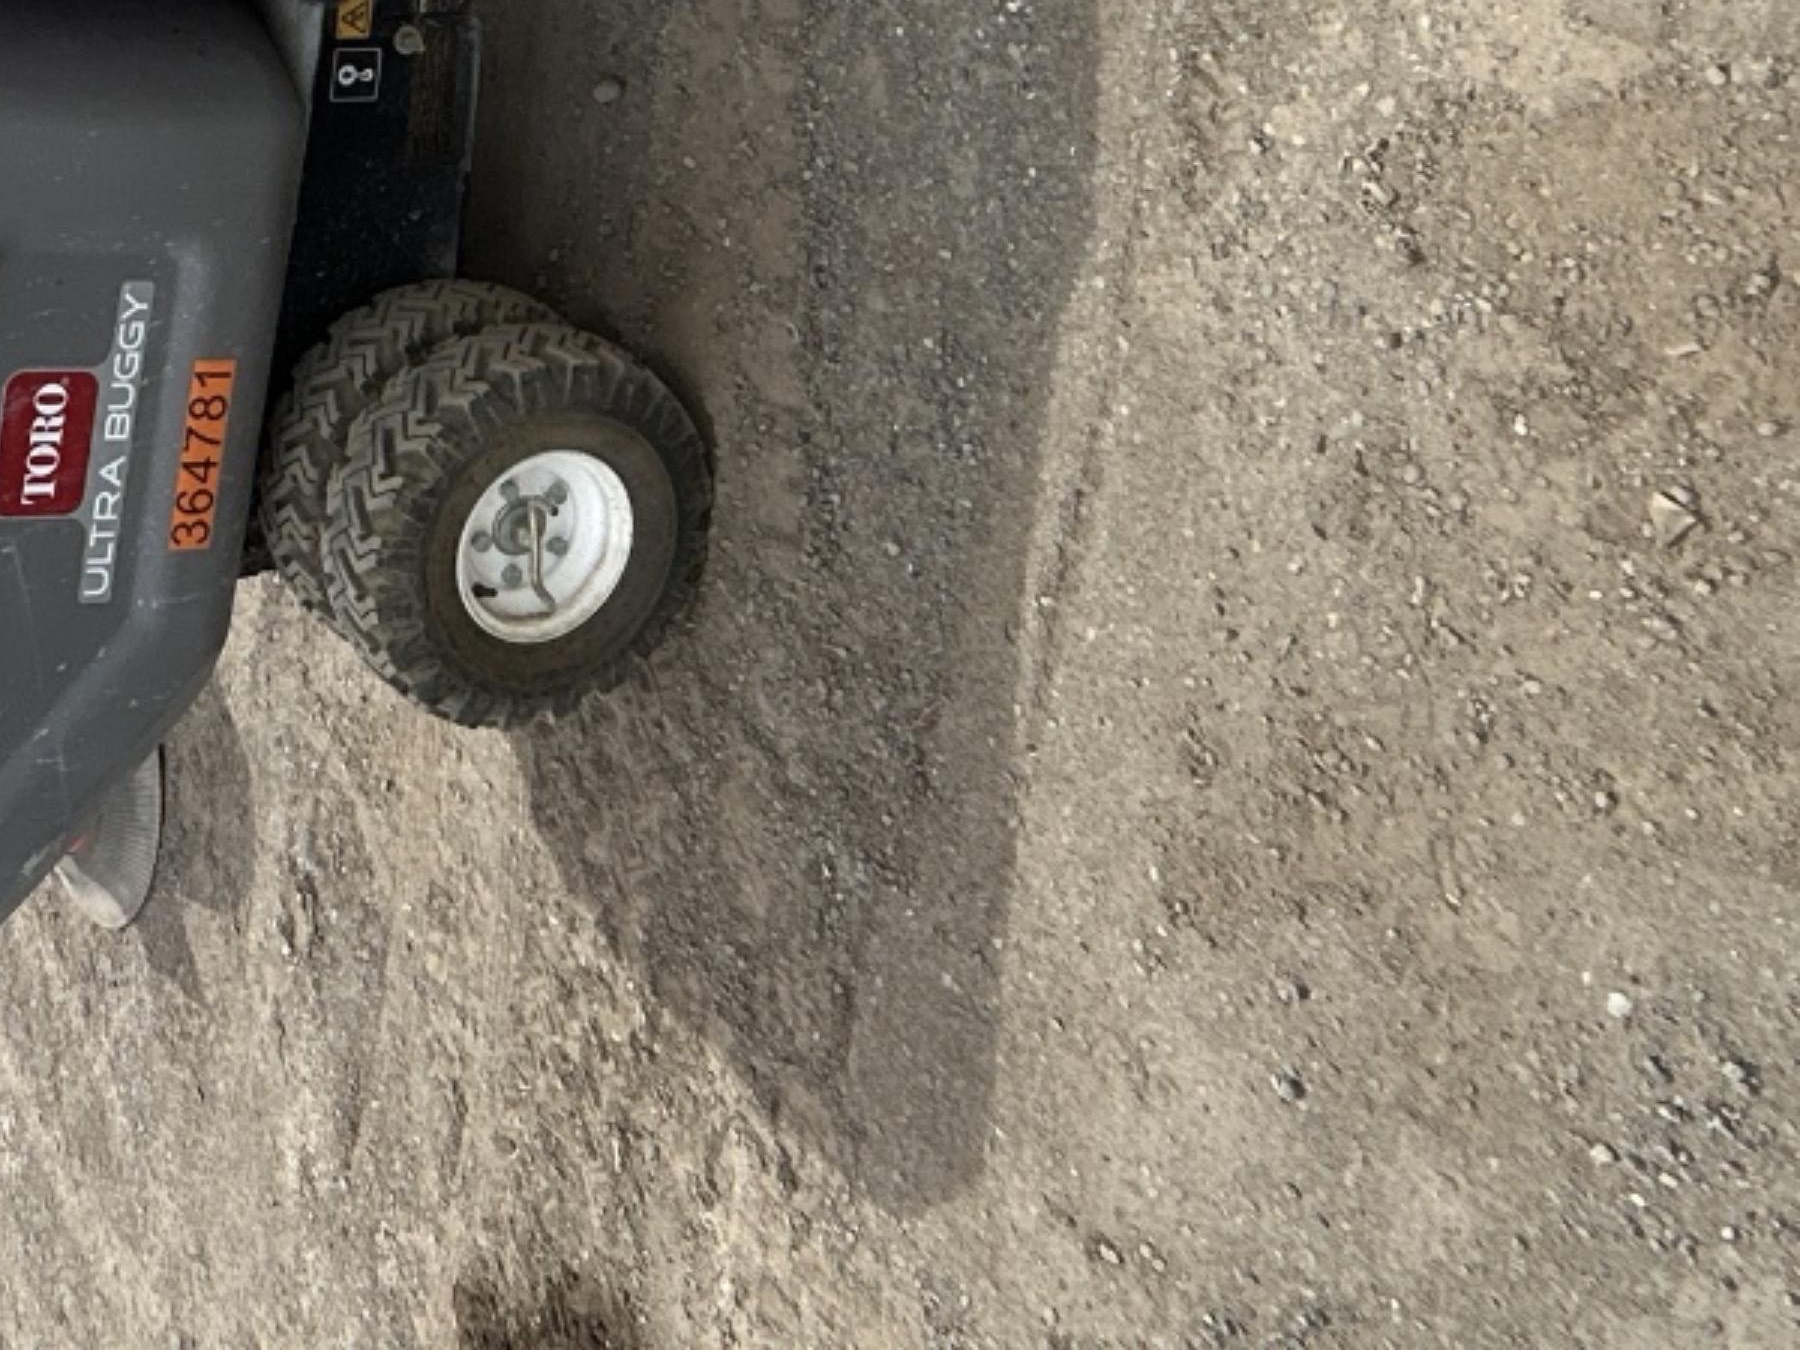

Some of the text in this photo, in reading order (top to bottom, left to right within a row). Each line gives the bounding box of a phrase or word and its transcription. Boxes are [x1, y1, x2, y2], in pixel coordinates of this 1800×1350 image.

[21, 383, 69, 505] TORO
[83, 293, 148, 598] ULTRA BUGGY
[171, 368, 232, 545] 364781
